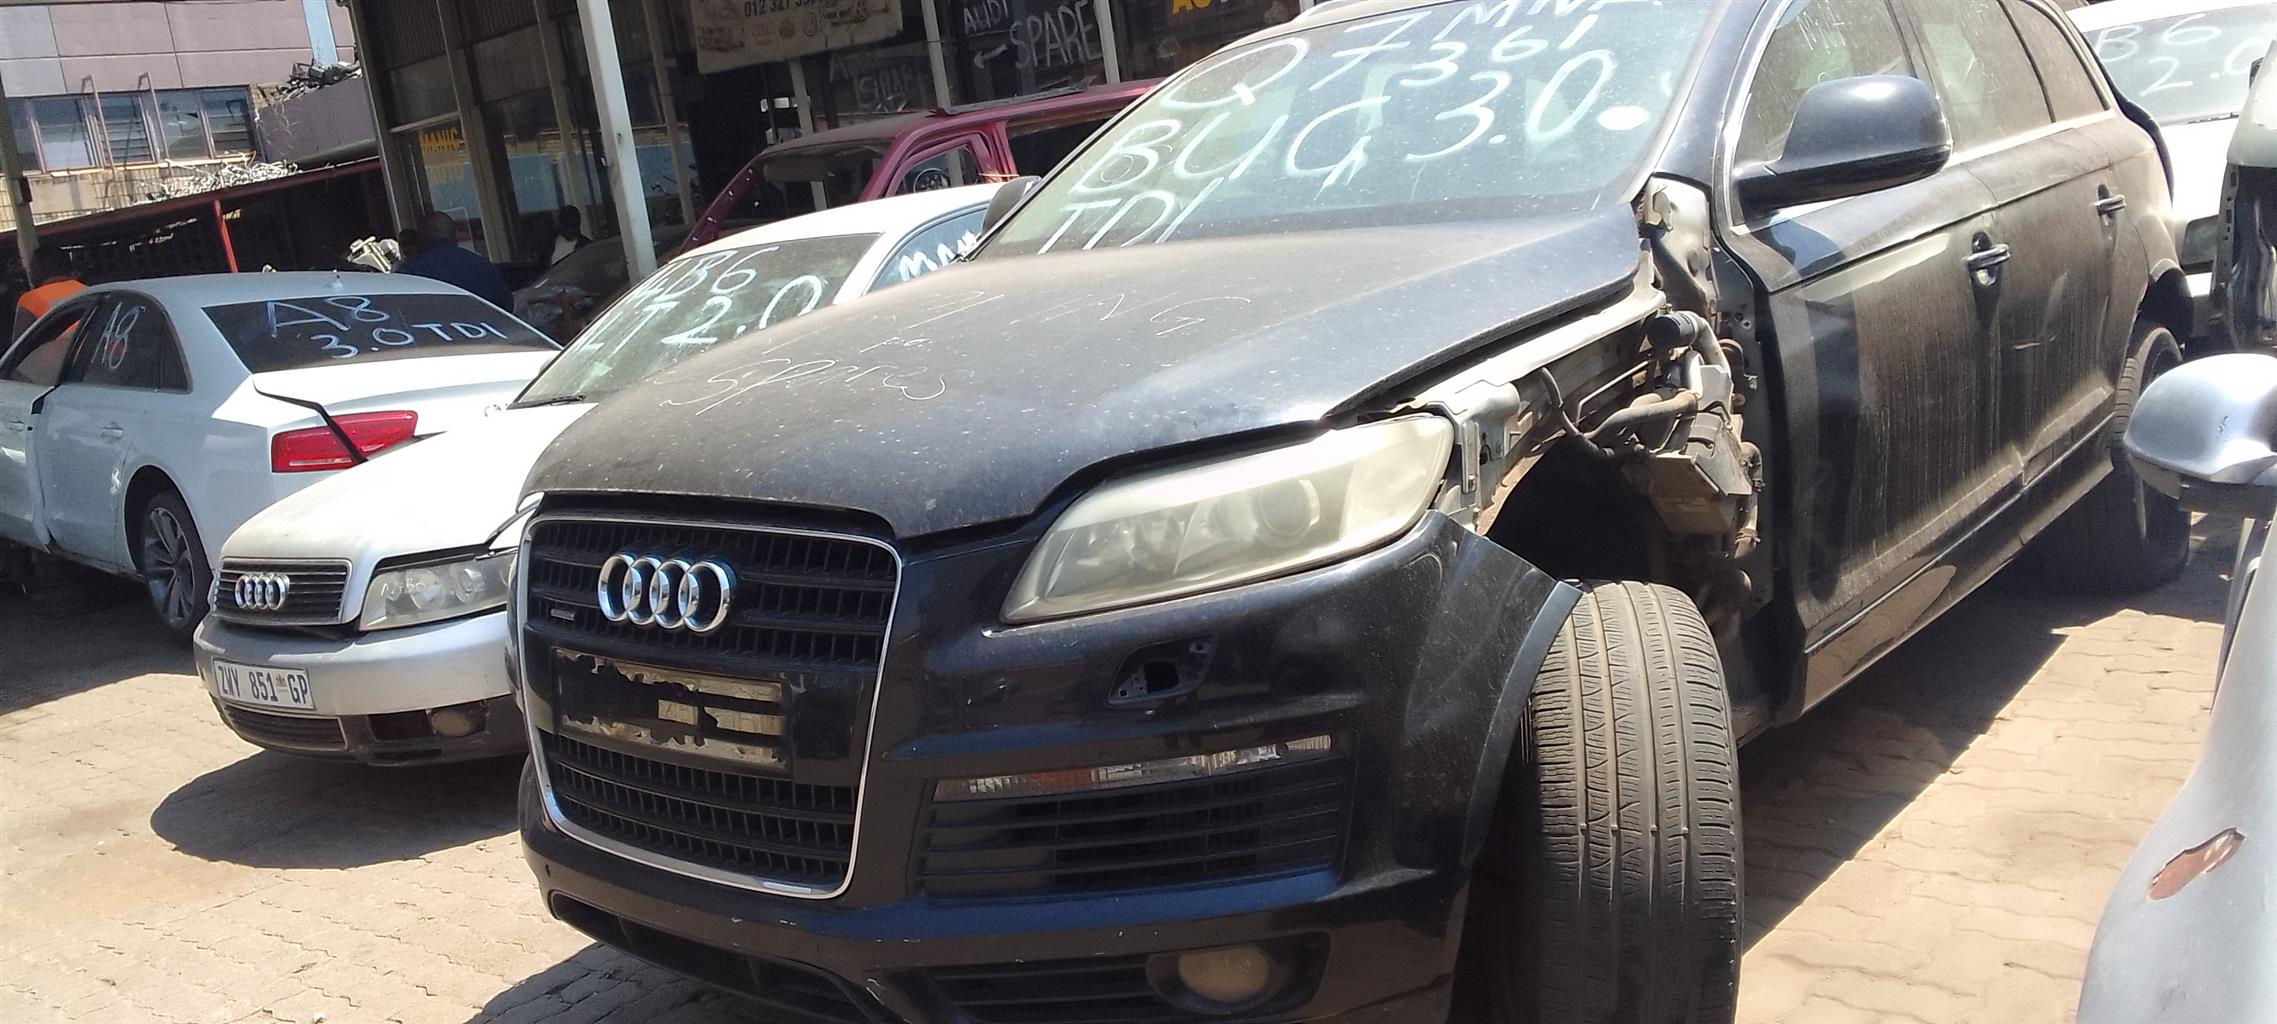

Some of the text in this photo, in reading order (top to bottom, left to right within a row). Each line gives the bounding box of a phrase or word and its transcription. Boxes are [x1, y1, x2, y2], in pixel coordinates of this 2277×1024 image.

[1161, 15, 1432, 110] Q7
[1400, 14, 1600, 88] 361
[2095, 13, 2223, 62] B6
[1406, 49, 1620, 163] 3.0
[1037, 177, 1224, 255] TDI
[91, 300, 140, 370] A8
[265, 295, 390, 338] A8
[660, 273, 830, 348] 2.0
[248, 670, 279, 702] 851
[286, 673, 309, 704] GP
